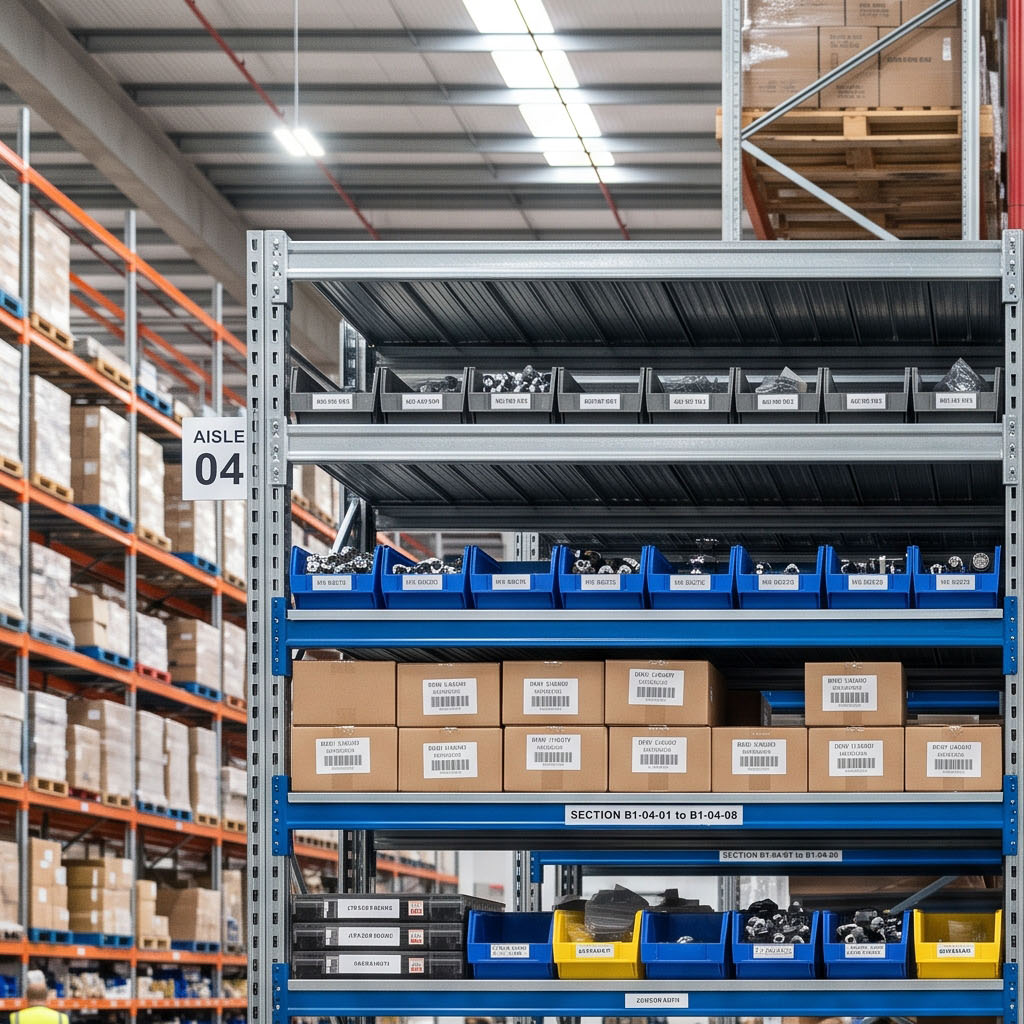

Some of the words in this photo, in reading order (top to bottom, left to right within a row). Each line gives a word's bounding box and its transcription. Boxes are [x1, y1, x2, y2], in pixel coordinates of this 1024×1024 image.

[193, 430, 245, 443] AISLE
[196, 453, 243, 485] 04
[571, 810, 620, 819] SECTION
[625, 810, 671, 819] B1-04-01
[676, 811, 686, 819] to
[691, 810, 738, 819] B1-04-08
